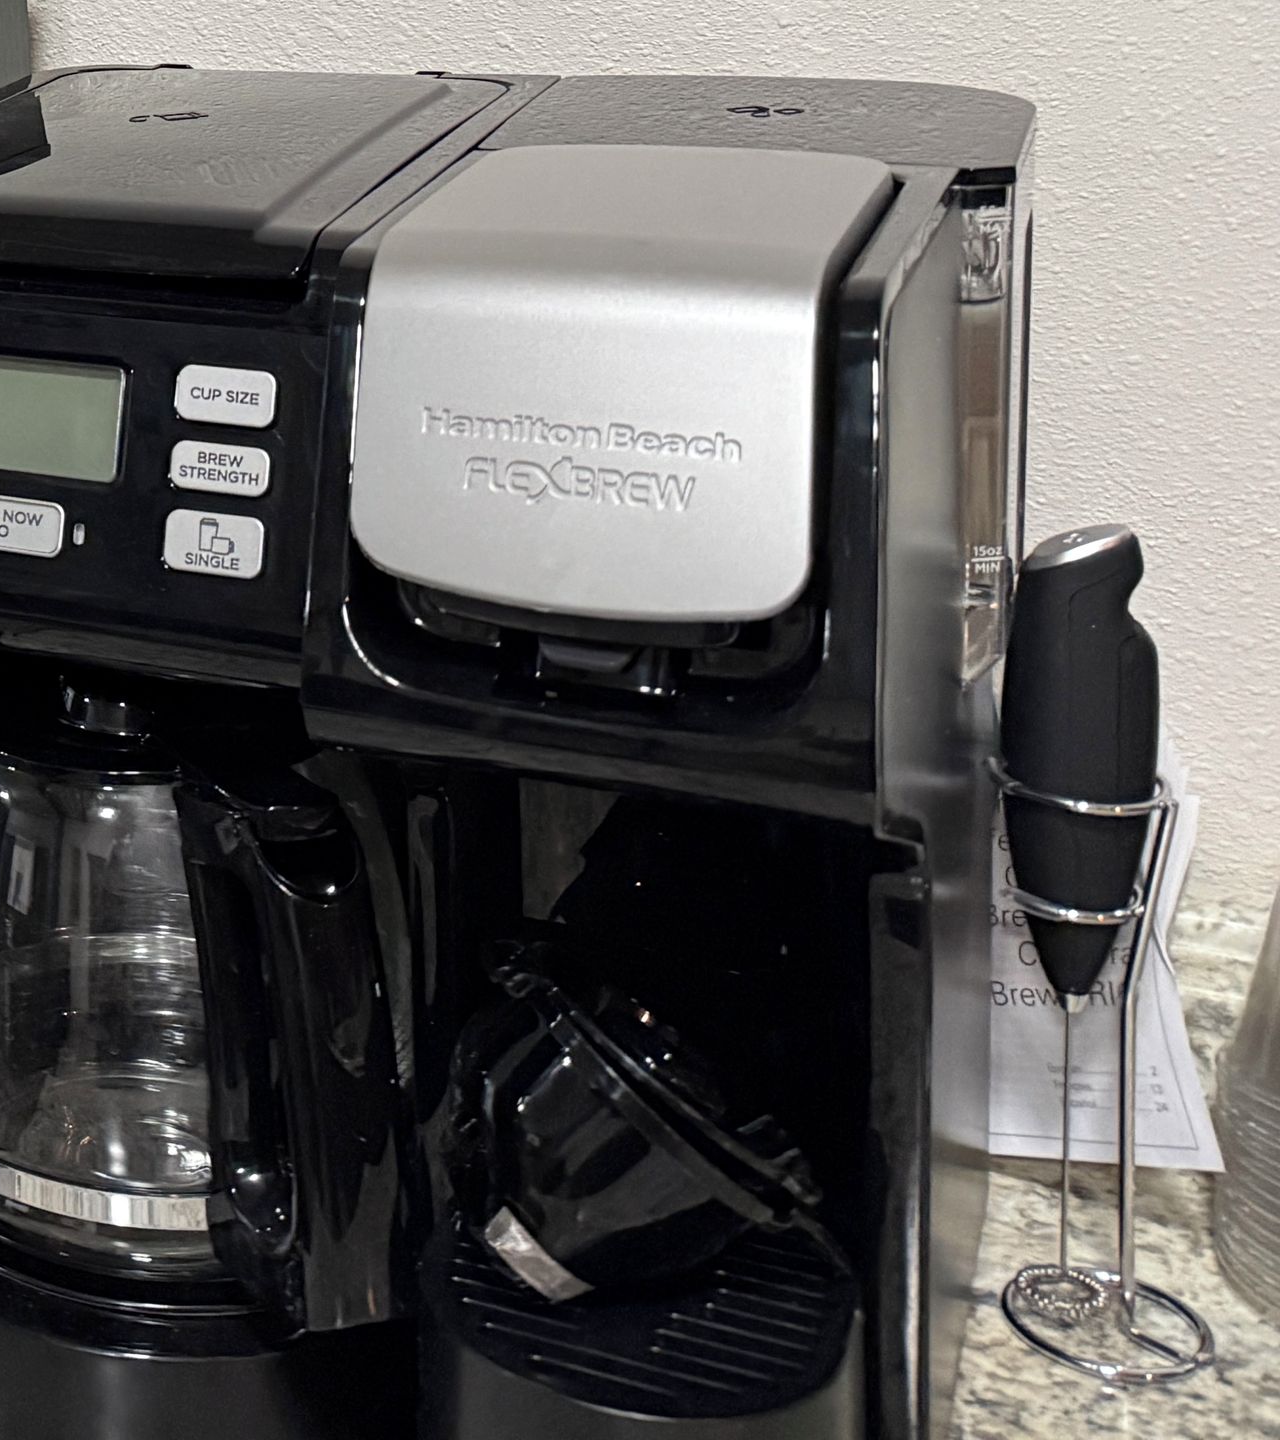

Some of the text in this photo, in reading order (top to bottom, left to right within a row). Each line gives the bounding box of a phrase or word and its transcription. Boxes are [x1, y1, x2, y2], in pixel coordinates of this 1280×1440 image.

[190, 386, 260, 406] CUP SIZE
[420, 406, 742, 464] Hamilton Beach
[197, 451, 244, 468] BREW
[178, 464, 260, 486] STRENGTH
[462, 455, 697, 513] FLEXBREW
[2, 509, 43, 527] NOW
[184, 552, 240, 571] SINGLE
[975, 561, 1000, 574] MIN
